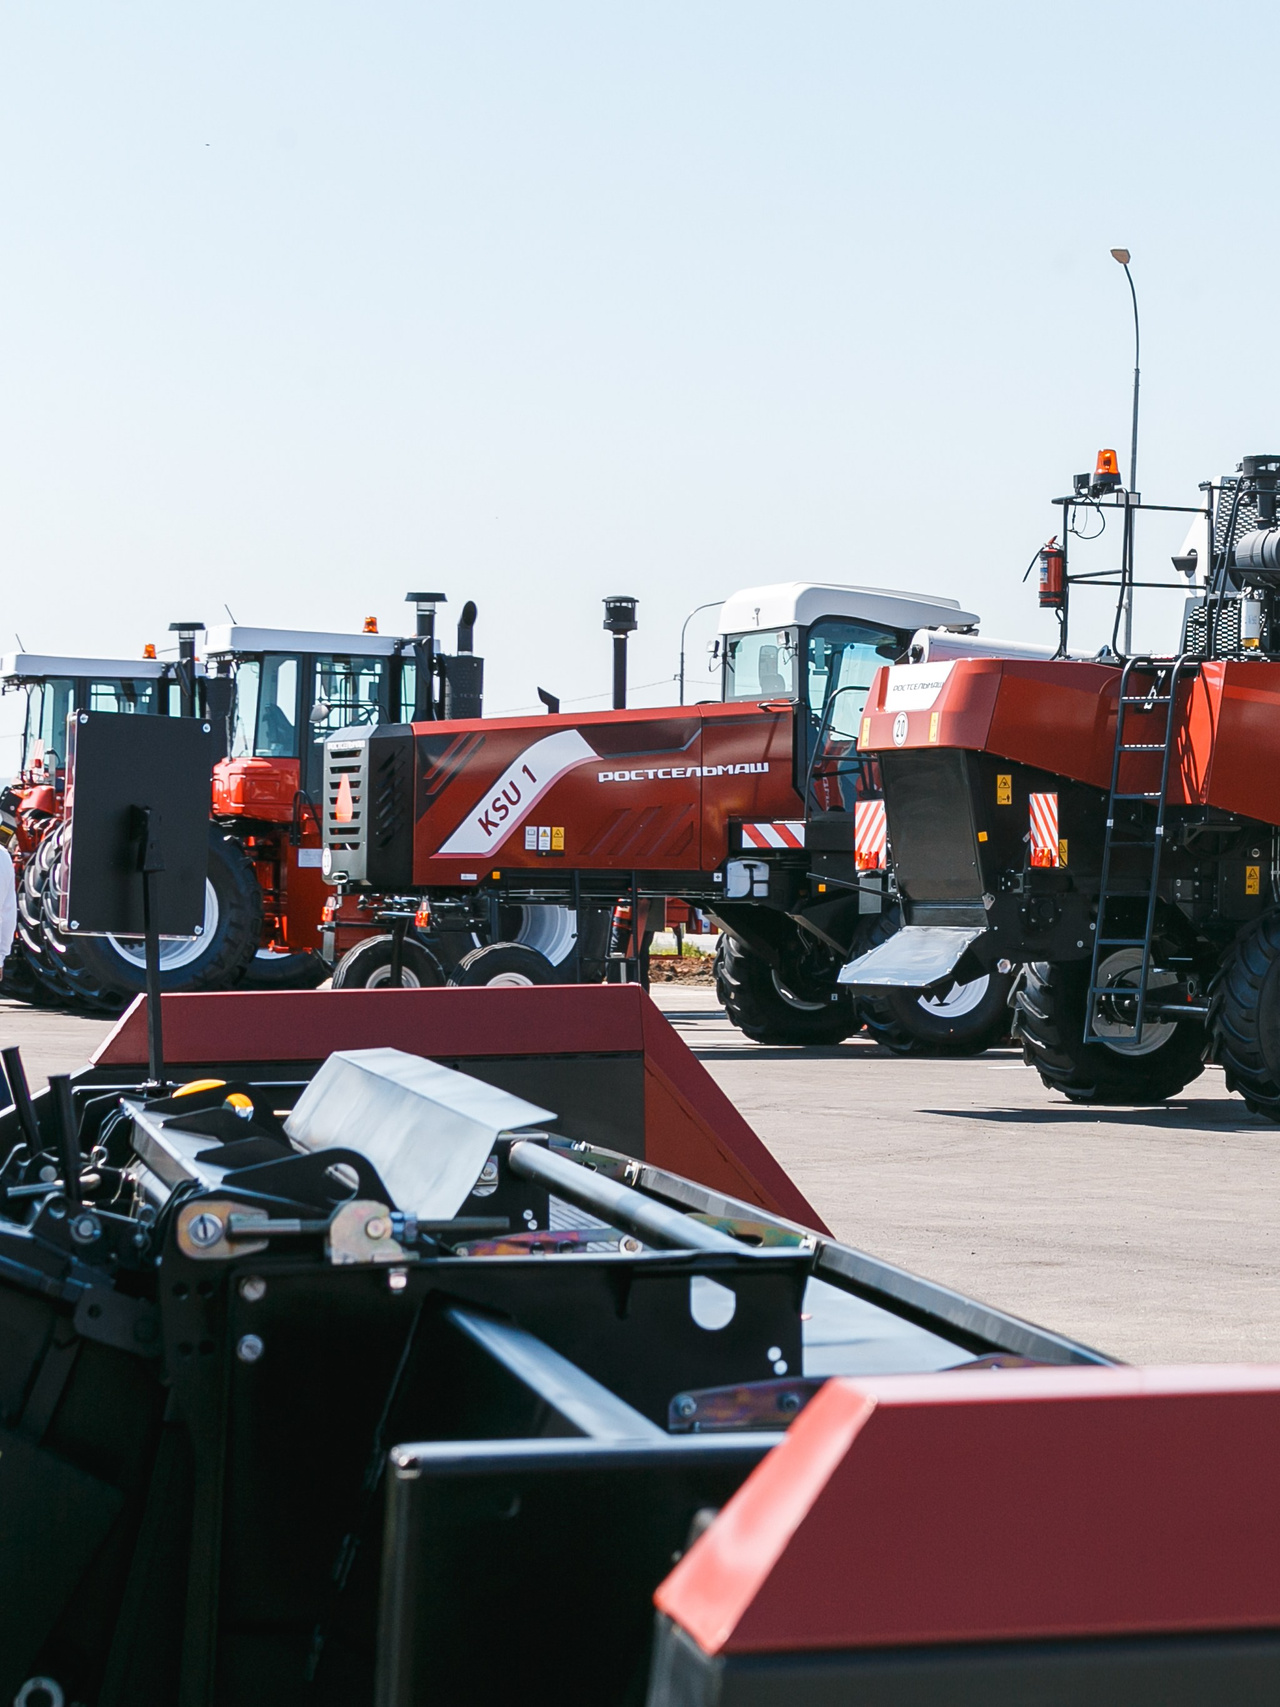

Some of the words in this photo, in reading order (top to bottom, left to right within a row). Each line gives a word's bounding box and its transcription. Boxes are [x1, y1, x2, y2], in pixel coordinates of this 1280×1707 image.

[598, 762, 769, 783] РОСТСЕЛЬМАШ
[477, 780, 522, 837] KSU
[521, 763, 537, 784] 1
